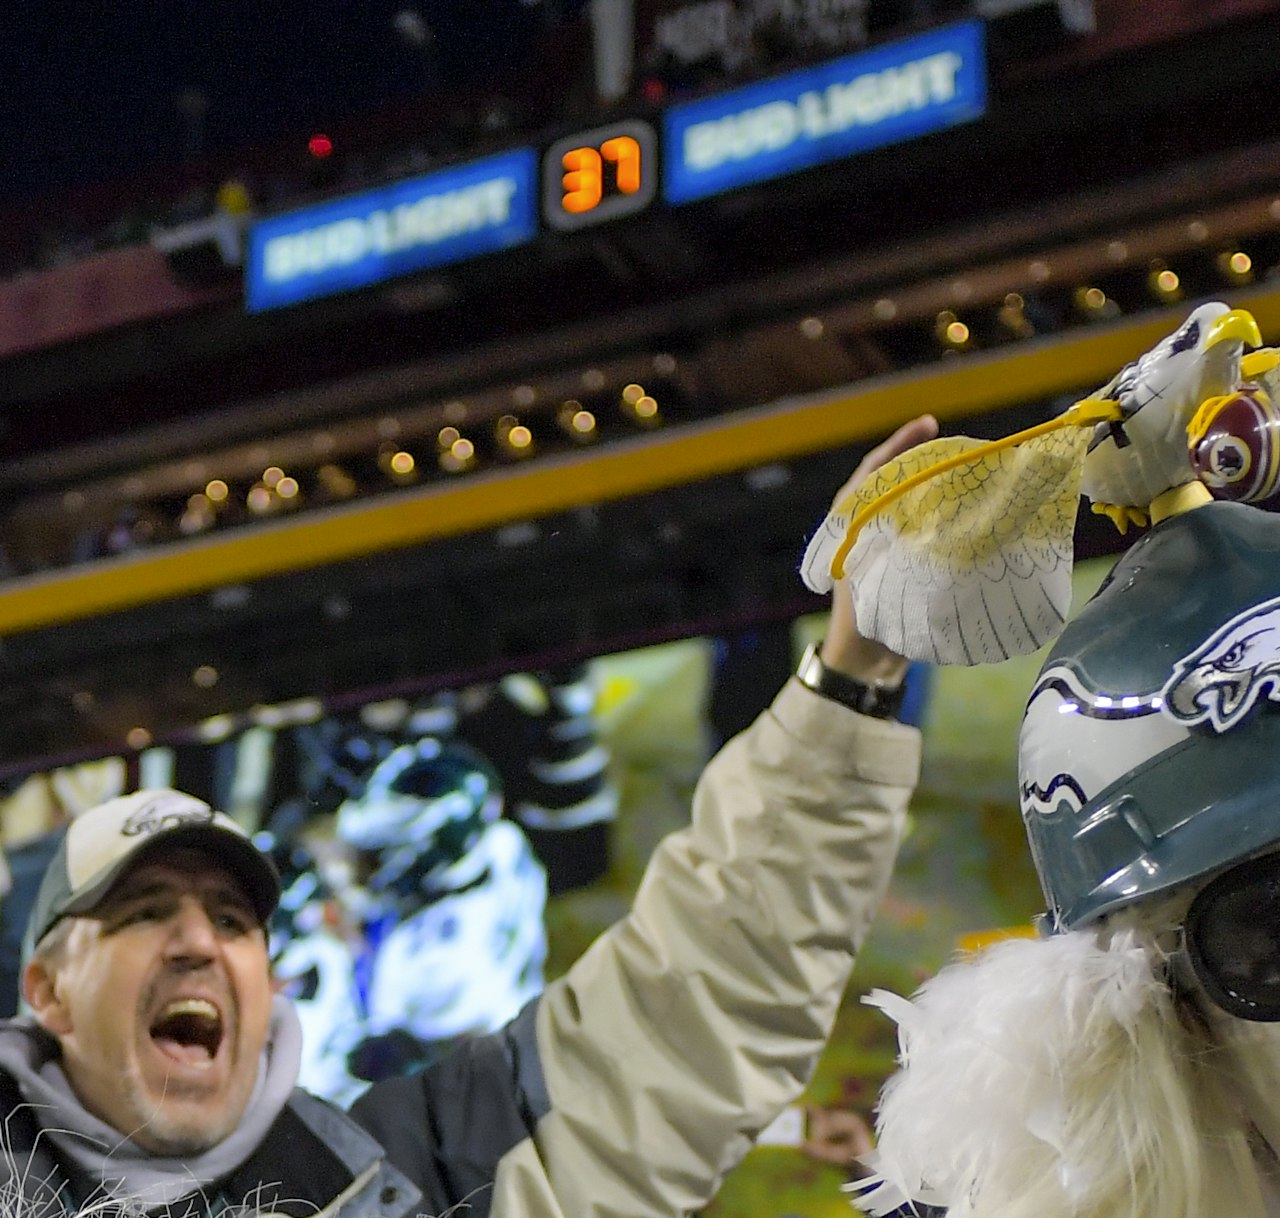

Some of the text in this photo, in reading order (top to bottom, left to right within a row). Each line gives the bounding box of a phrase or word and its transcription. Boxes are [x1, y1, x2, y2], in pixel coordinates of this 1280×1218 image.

[683, 50, 963, 173] BUD LIGHT
[561, 136, 641, 214] 37
[264, 176, 518, 284] BUD LIGHT
